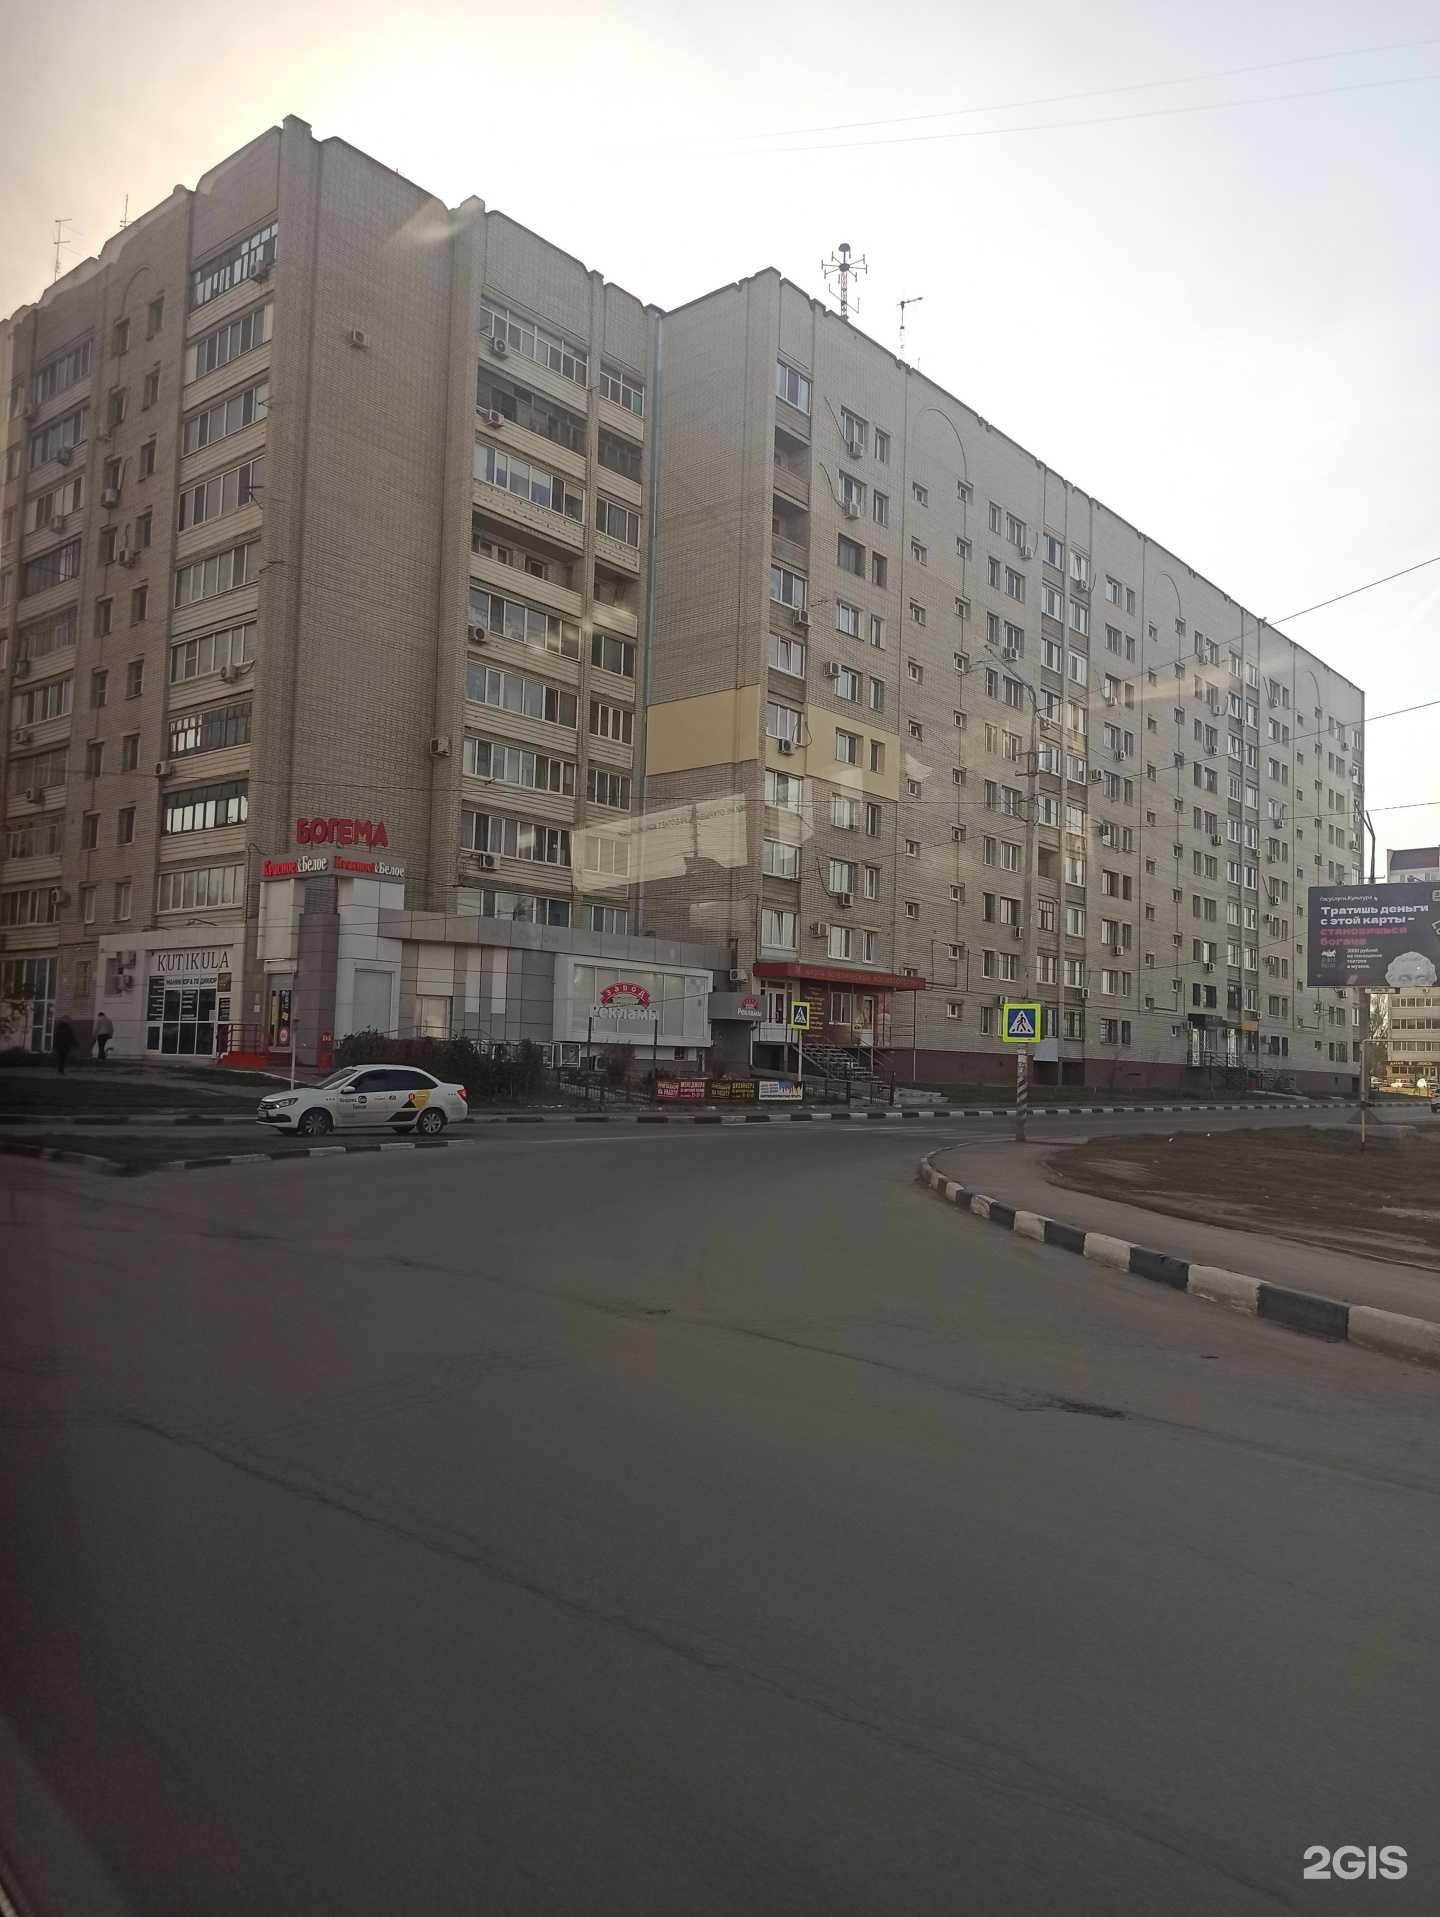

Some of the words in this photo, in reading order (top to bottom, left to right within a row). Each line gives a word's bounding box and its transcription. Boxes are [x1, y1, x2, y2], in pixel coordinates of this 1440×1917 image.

[296, 816, 389, 848] БОГЕМА
[1320, 906, 1378, 917] Тратишь
[1380, 905, 1429, 914] деньги
[1320, 918, 1329, 926] с
[1330, 915, 1360, 926] этой
[1363, 917, 1406, 927] карты
[157, 951, 229, 972] KUTIKULA
